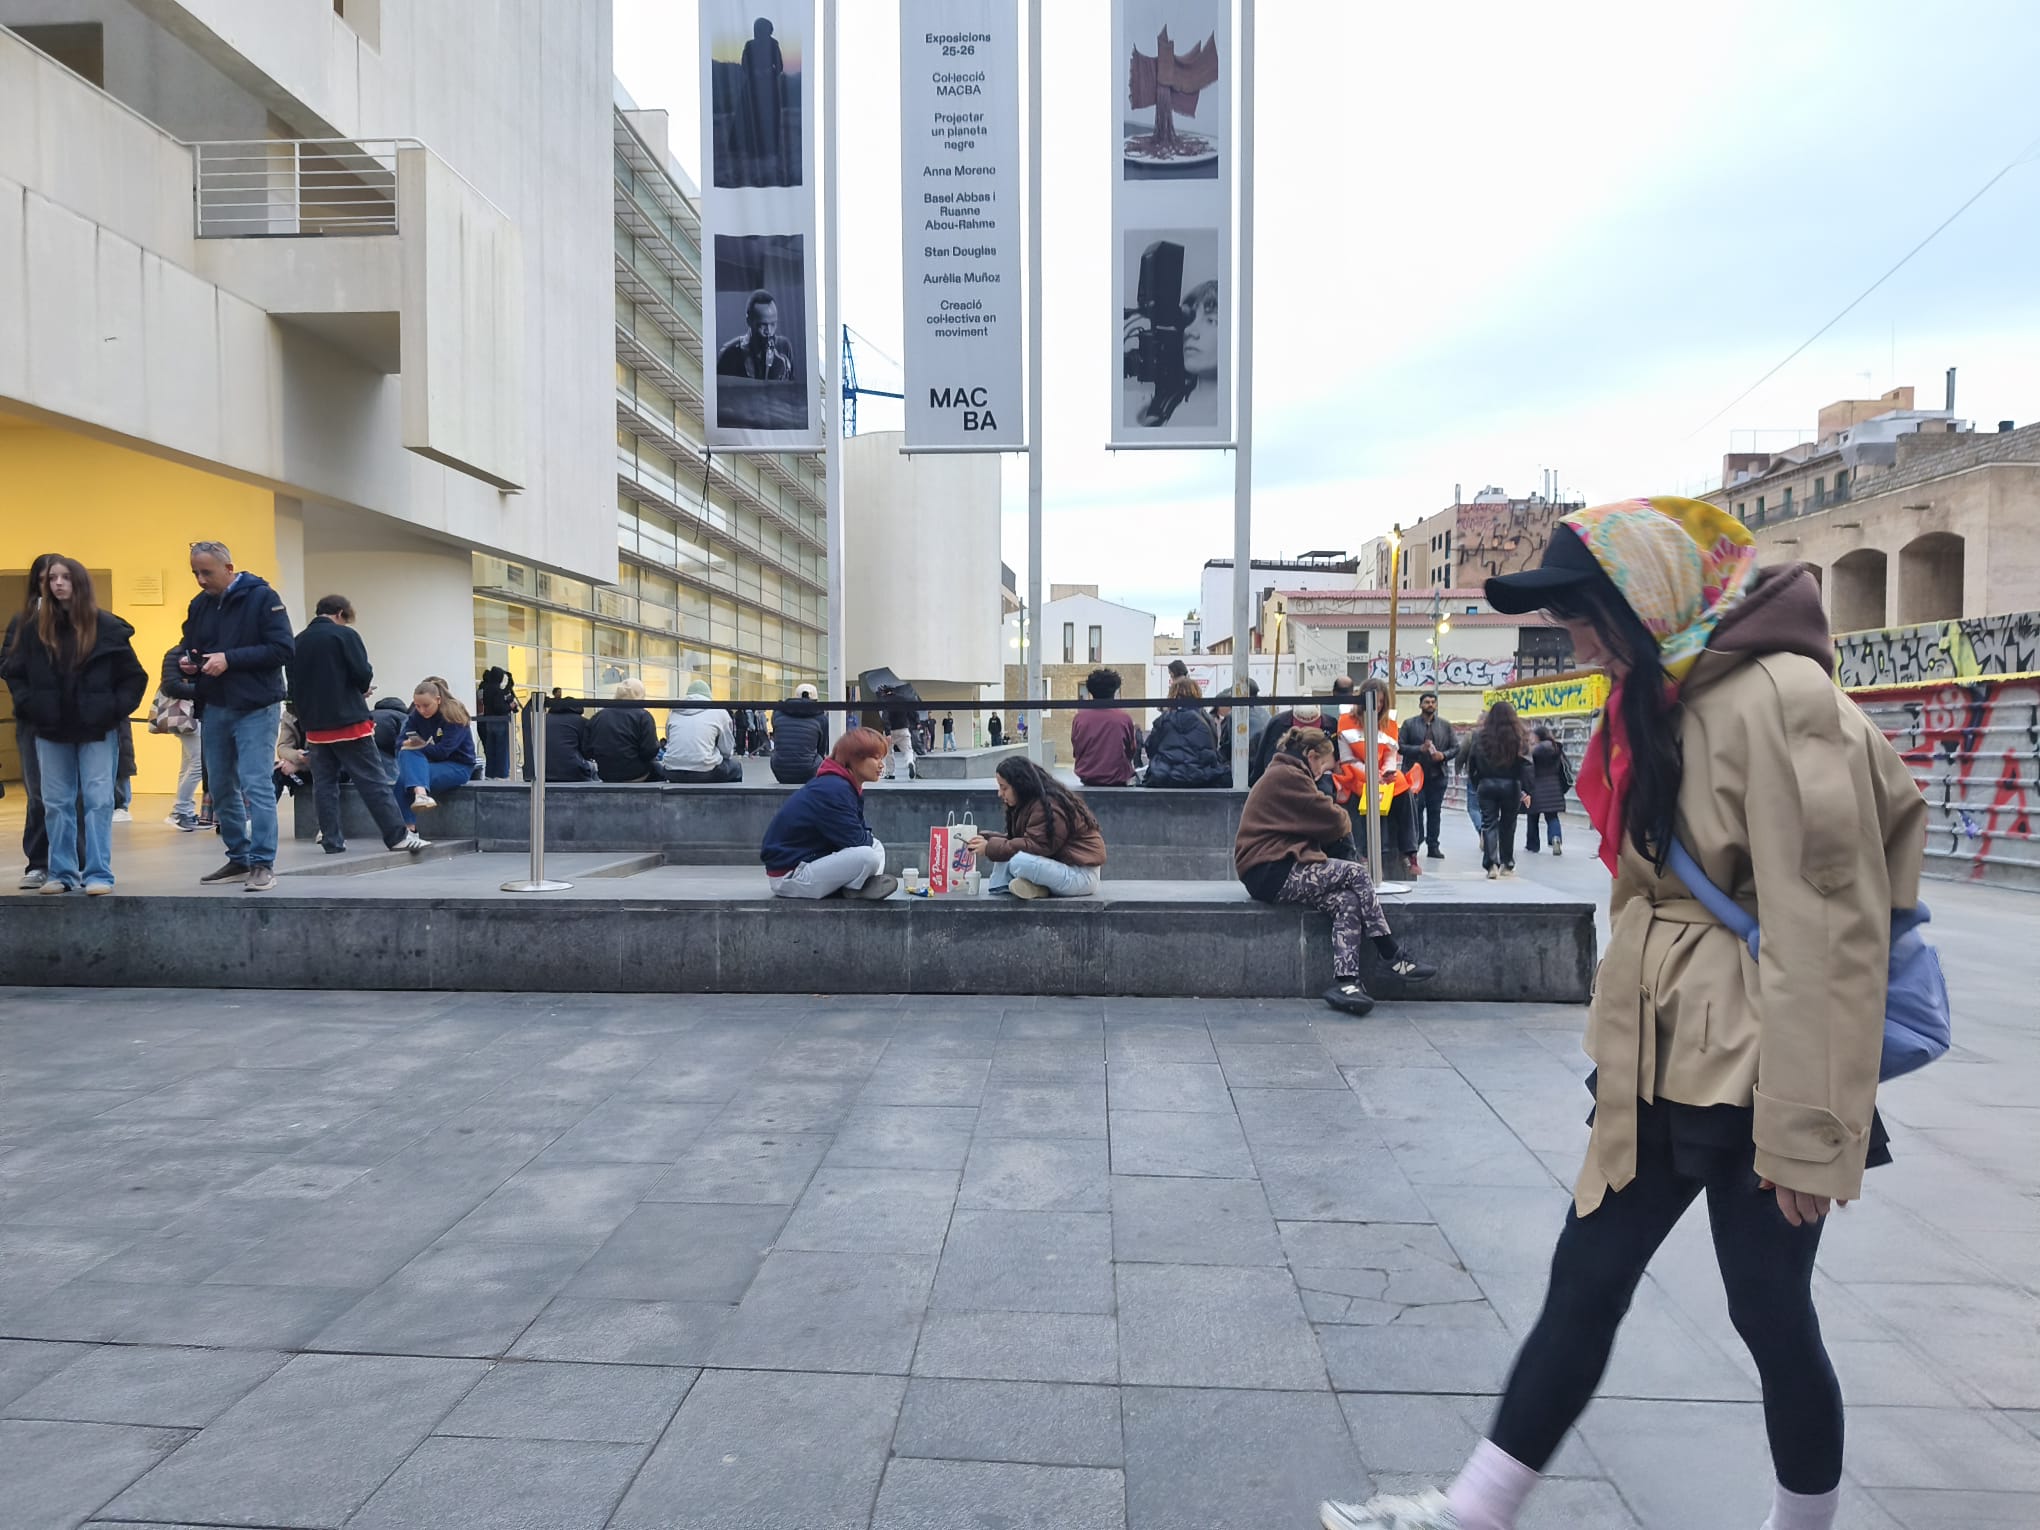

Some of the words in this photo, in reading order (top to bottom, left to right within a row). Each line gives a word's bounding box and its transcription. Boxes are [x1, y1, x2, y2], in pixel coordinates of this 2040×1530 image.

[925, 32, 992, 46] Exposicions
[941, 45, 976, 57] 25-26
[936, 85, 982, 97] MACBA
[934, 112, 985, 127] Projectar
[931, 128, 945, 137] un
[947, 125, 988, 139] planeta
[943, 137, 975, 153] negre
[922, 166, 952, 177] Anna
[954, 165, 996, 177] Moreno
[923, 193, 954, 204] Basel
[955, 192, 991, 204] Abbas
[939, 206, 981, 217] Ruanne
[924, 219, 996, 231] Abou-Rahme
[924, 247, 950, 258] Stan
[952, 245, 997, 259] Douglas
[922, 273, 962, 284] Aurèlia
[963, 272, 1001, 284] Muñoz
[939, 299, 983, 311] Creació
[926, 313, 981, 325] col·lectiva
[982, 315, 997, 324] en
[934, 326, 989, 338] moviment
[929, 387, 988, 408] MAC
[963, 410, 998, 431] BA
